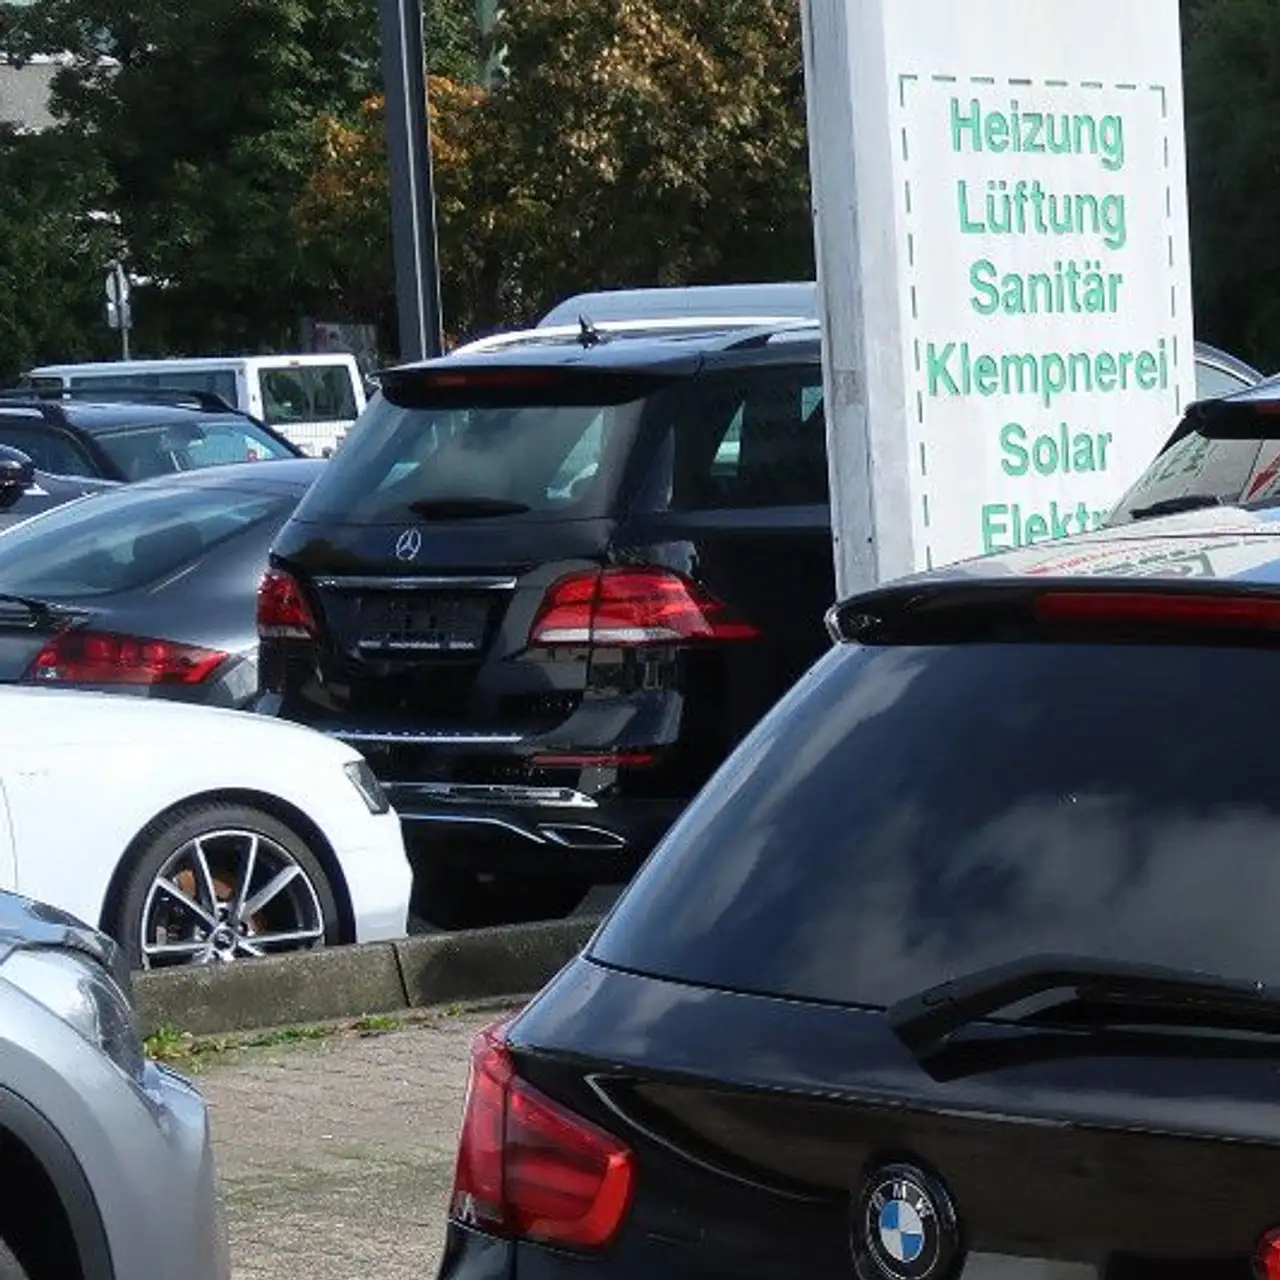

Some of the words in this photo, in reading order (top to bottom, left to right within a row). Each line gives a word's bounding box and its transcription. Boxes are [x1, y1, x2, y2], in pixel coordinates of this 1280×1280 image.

[950, 97, 1125, 171] Heizung
[957, 179, 1126, 250] Lüftung
[969, 258, 1125, 316] Sanitär
[925, 340, 1169, 408] Klempnerei
[999, 421, 1112, 477] Solar
[870, 1180, 934, 1218] BMW
